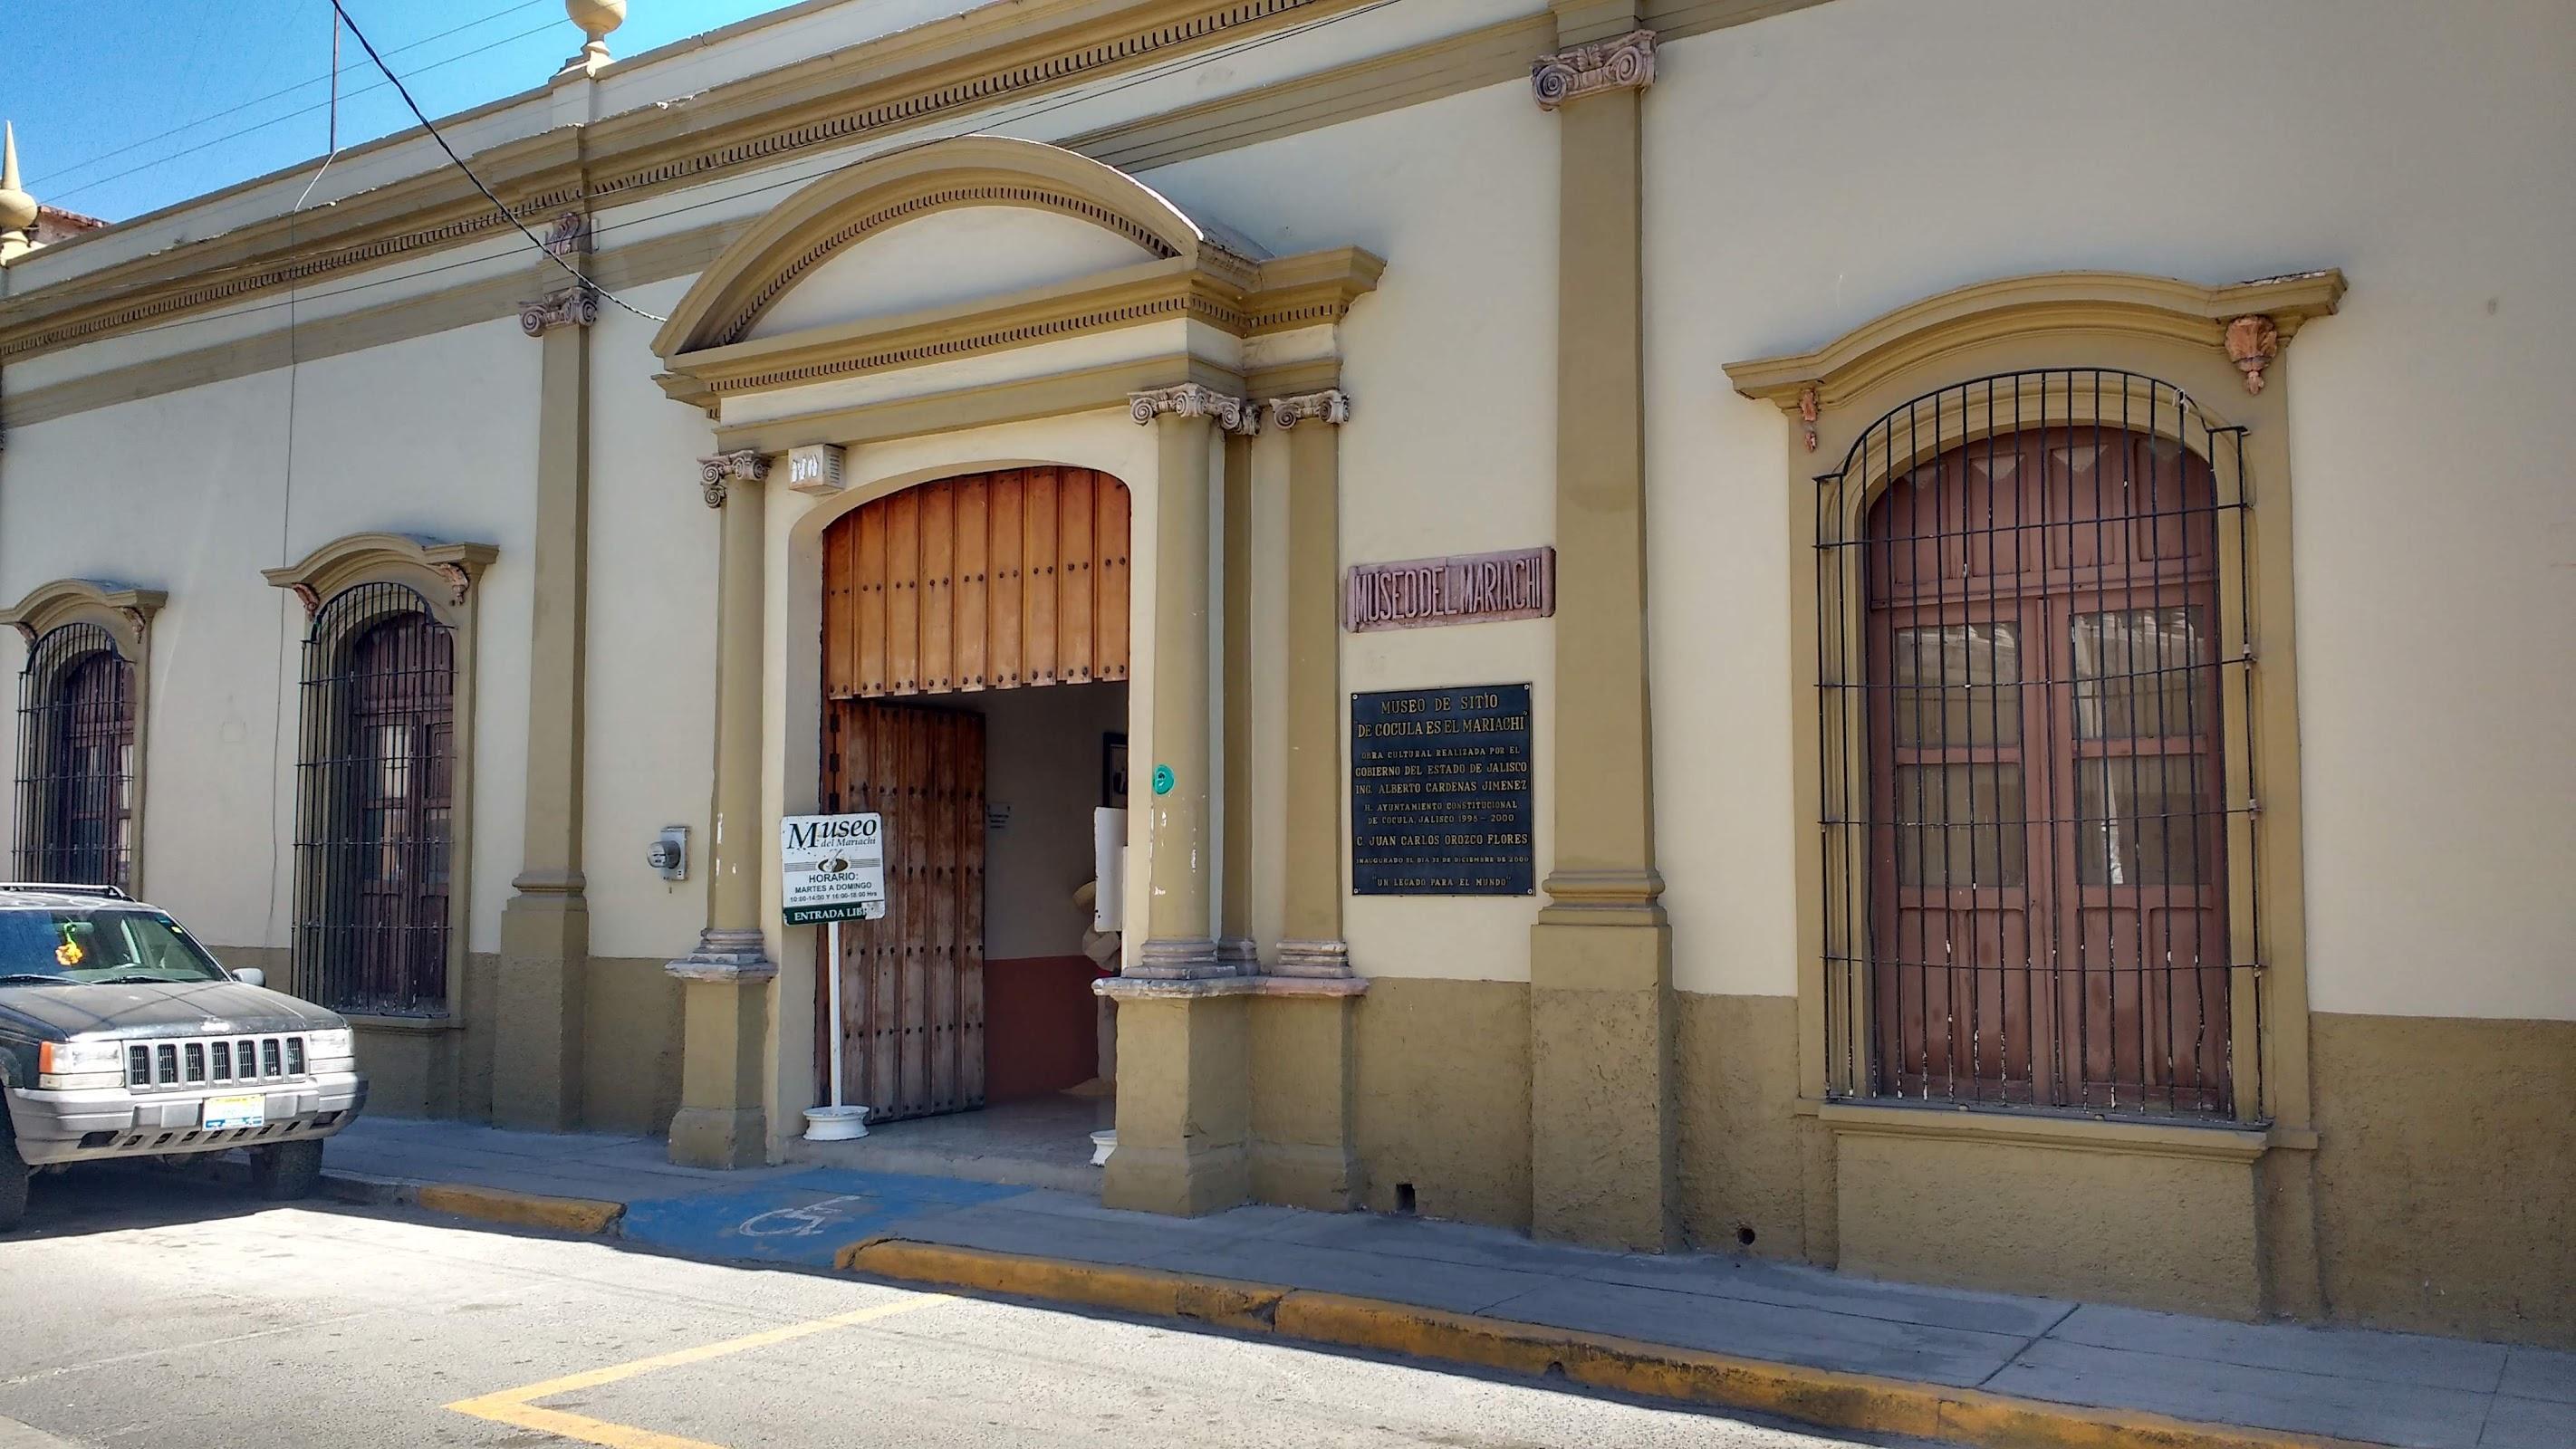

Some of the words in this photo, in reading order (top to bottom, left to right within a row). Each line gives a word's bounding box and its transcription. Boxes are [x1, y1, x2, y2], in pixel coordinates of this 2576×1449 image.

[1355, 570, 1417, 623] MUSEO
[1420, 566, 1457, 616] DEL
[1461, 557, 1540, 613] MARIACHI
[1381, 699, 1425, 714] MUSEO
[1435, 696, 1451, 711] DE
[1461, 693, 1498, 709] SITIO
[1376, 721, 1422, 736] COCULA
[1426, 721, 1441, 734] ES
[1445, 720, 1458, 733] EL
[1361, 751, 1383, 759] OBRA
[1388, 750, 1432, 758] CULTURAL
[1436, 748, 1485, 757] REALIZADA
[1510, 746, 1520, 754] EL
[1356, 766, 1400, 777] GOBIERNO
[1405, 765, 1422, 775] DEL
[1427, 764, 1466, 774] ESTADO
[1470, 763, 1482, 773] DE
[1486, 762, 1527, 772] JALISCO
[1379, 783, 1420, 794] ALBERTO
[1426, 782, 1476, 792] CARDENAS
[1482, 780, 1527, 791] JIMENEZ
[1378, 802, 1442, 811] AYUNTAMIENTO
[1447, 801, 1517, 809] CONSTITUCIONAL
[1418, 815, 1454, 823] JALISCO
[786, 820, 877, 849] Museo
[1370, 836, 1396, 846] JUAN
[1401, 835, 1439, 846] CARLOS
[1445, 835, 1483, 845] OROZCO
[1487, 834, 1527, 844] FLORES
[821, 840, 834, 848] del
[836, 838, 876, 847] Mariachi
[809, 873, 859, 882] HORARIO:
[837, 882, 871, 890] DOMINGO
[794, 909, 844, 920] ENTRADA
